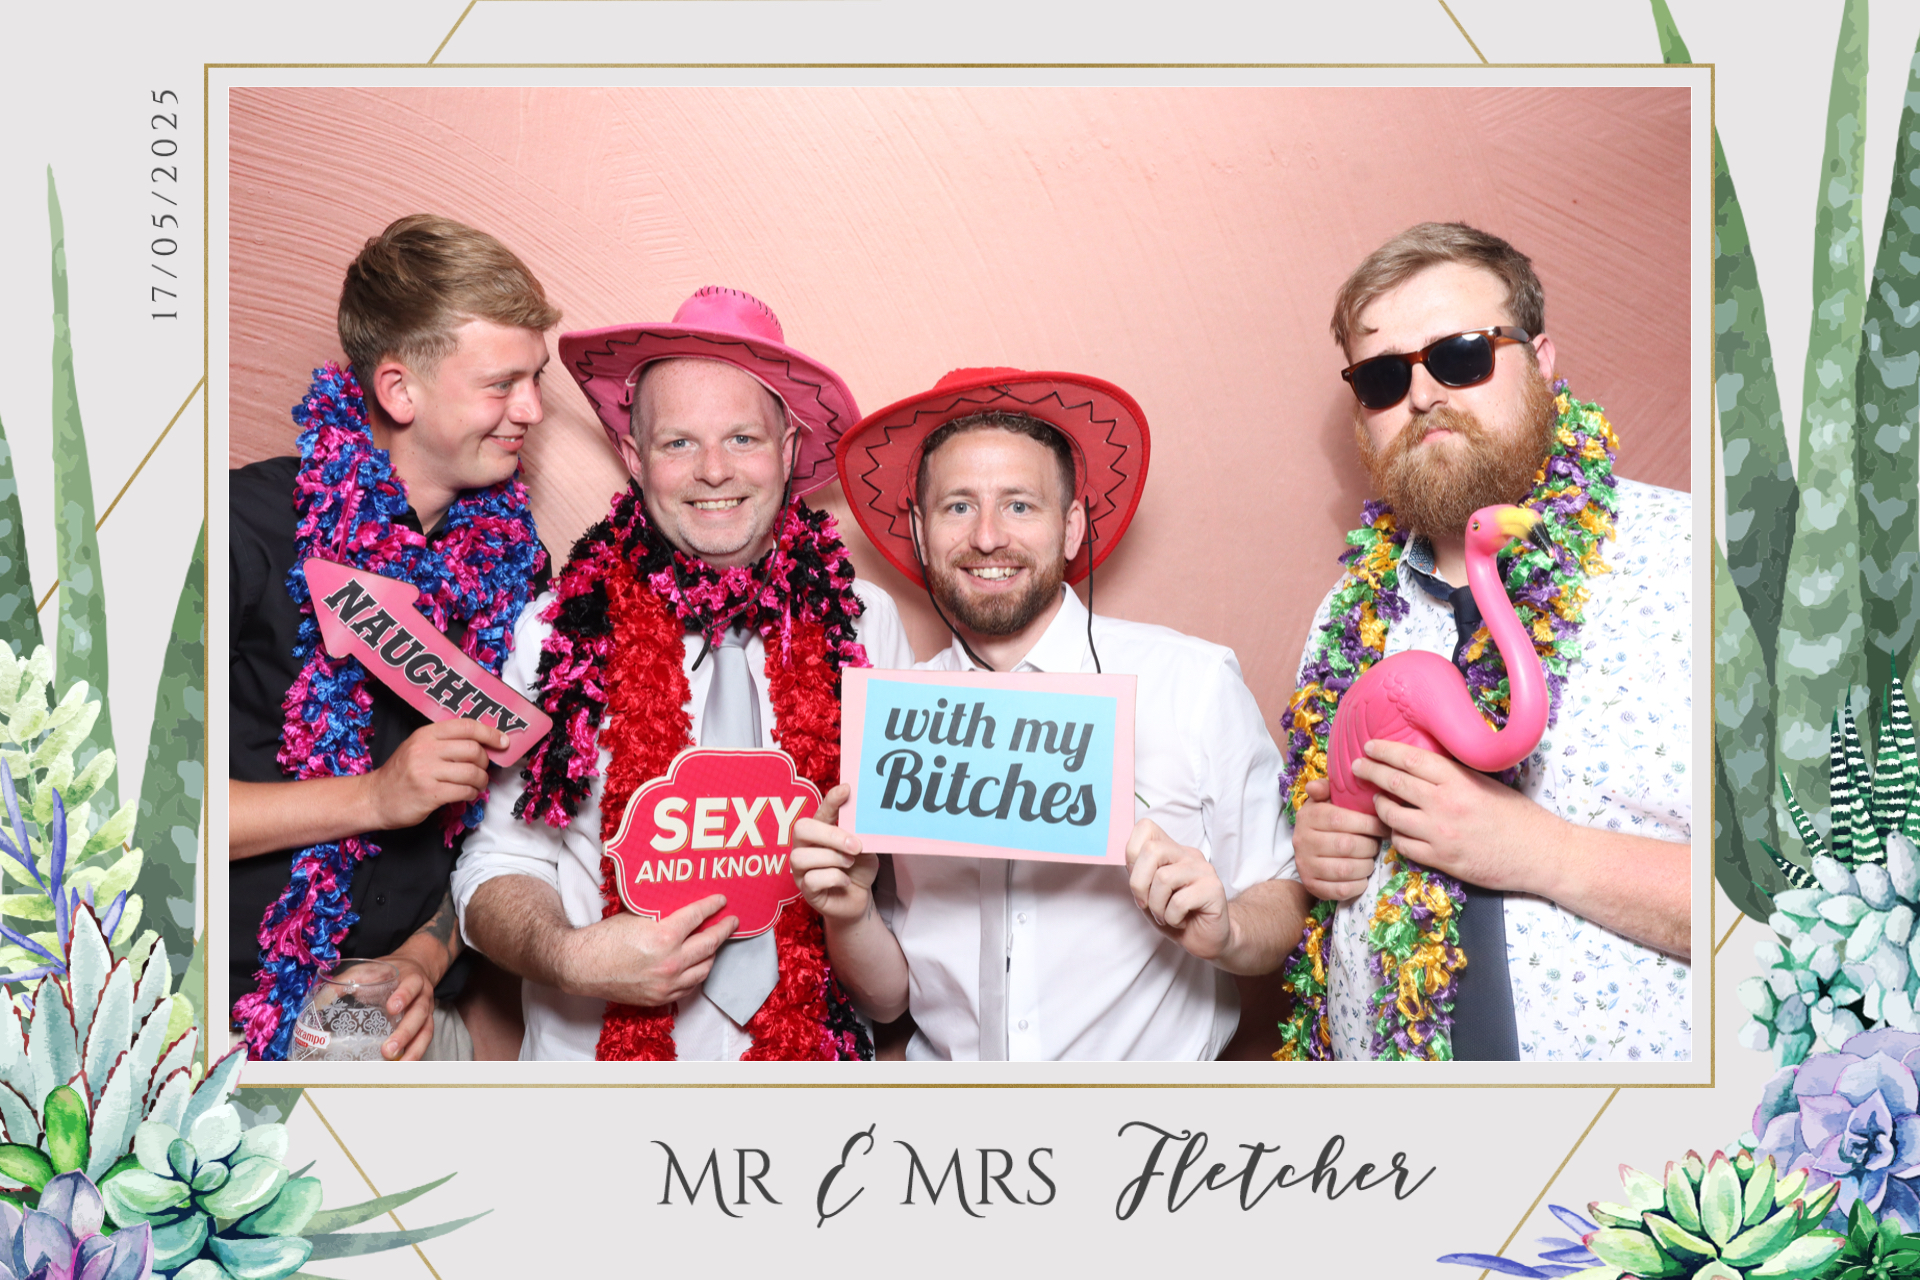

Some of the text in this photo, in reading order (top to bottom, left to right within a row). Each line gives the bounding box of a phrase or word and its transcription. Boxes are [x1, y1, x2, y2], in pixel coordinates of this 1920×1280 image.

[322, 577, 530, 733] NAUGHTY
[884, 698, 1094, 772] with my
[875, 748, 1097, 826] Bitches
[649, 796, 808, 854] SEXY
[634, 854, 787, 884] AND I KNOW
